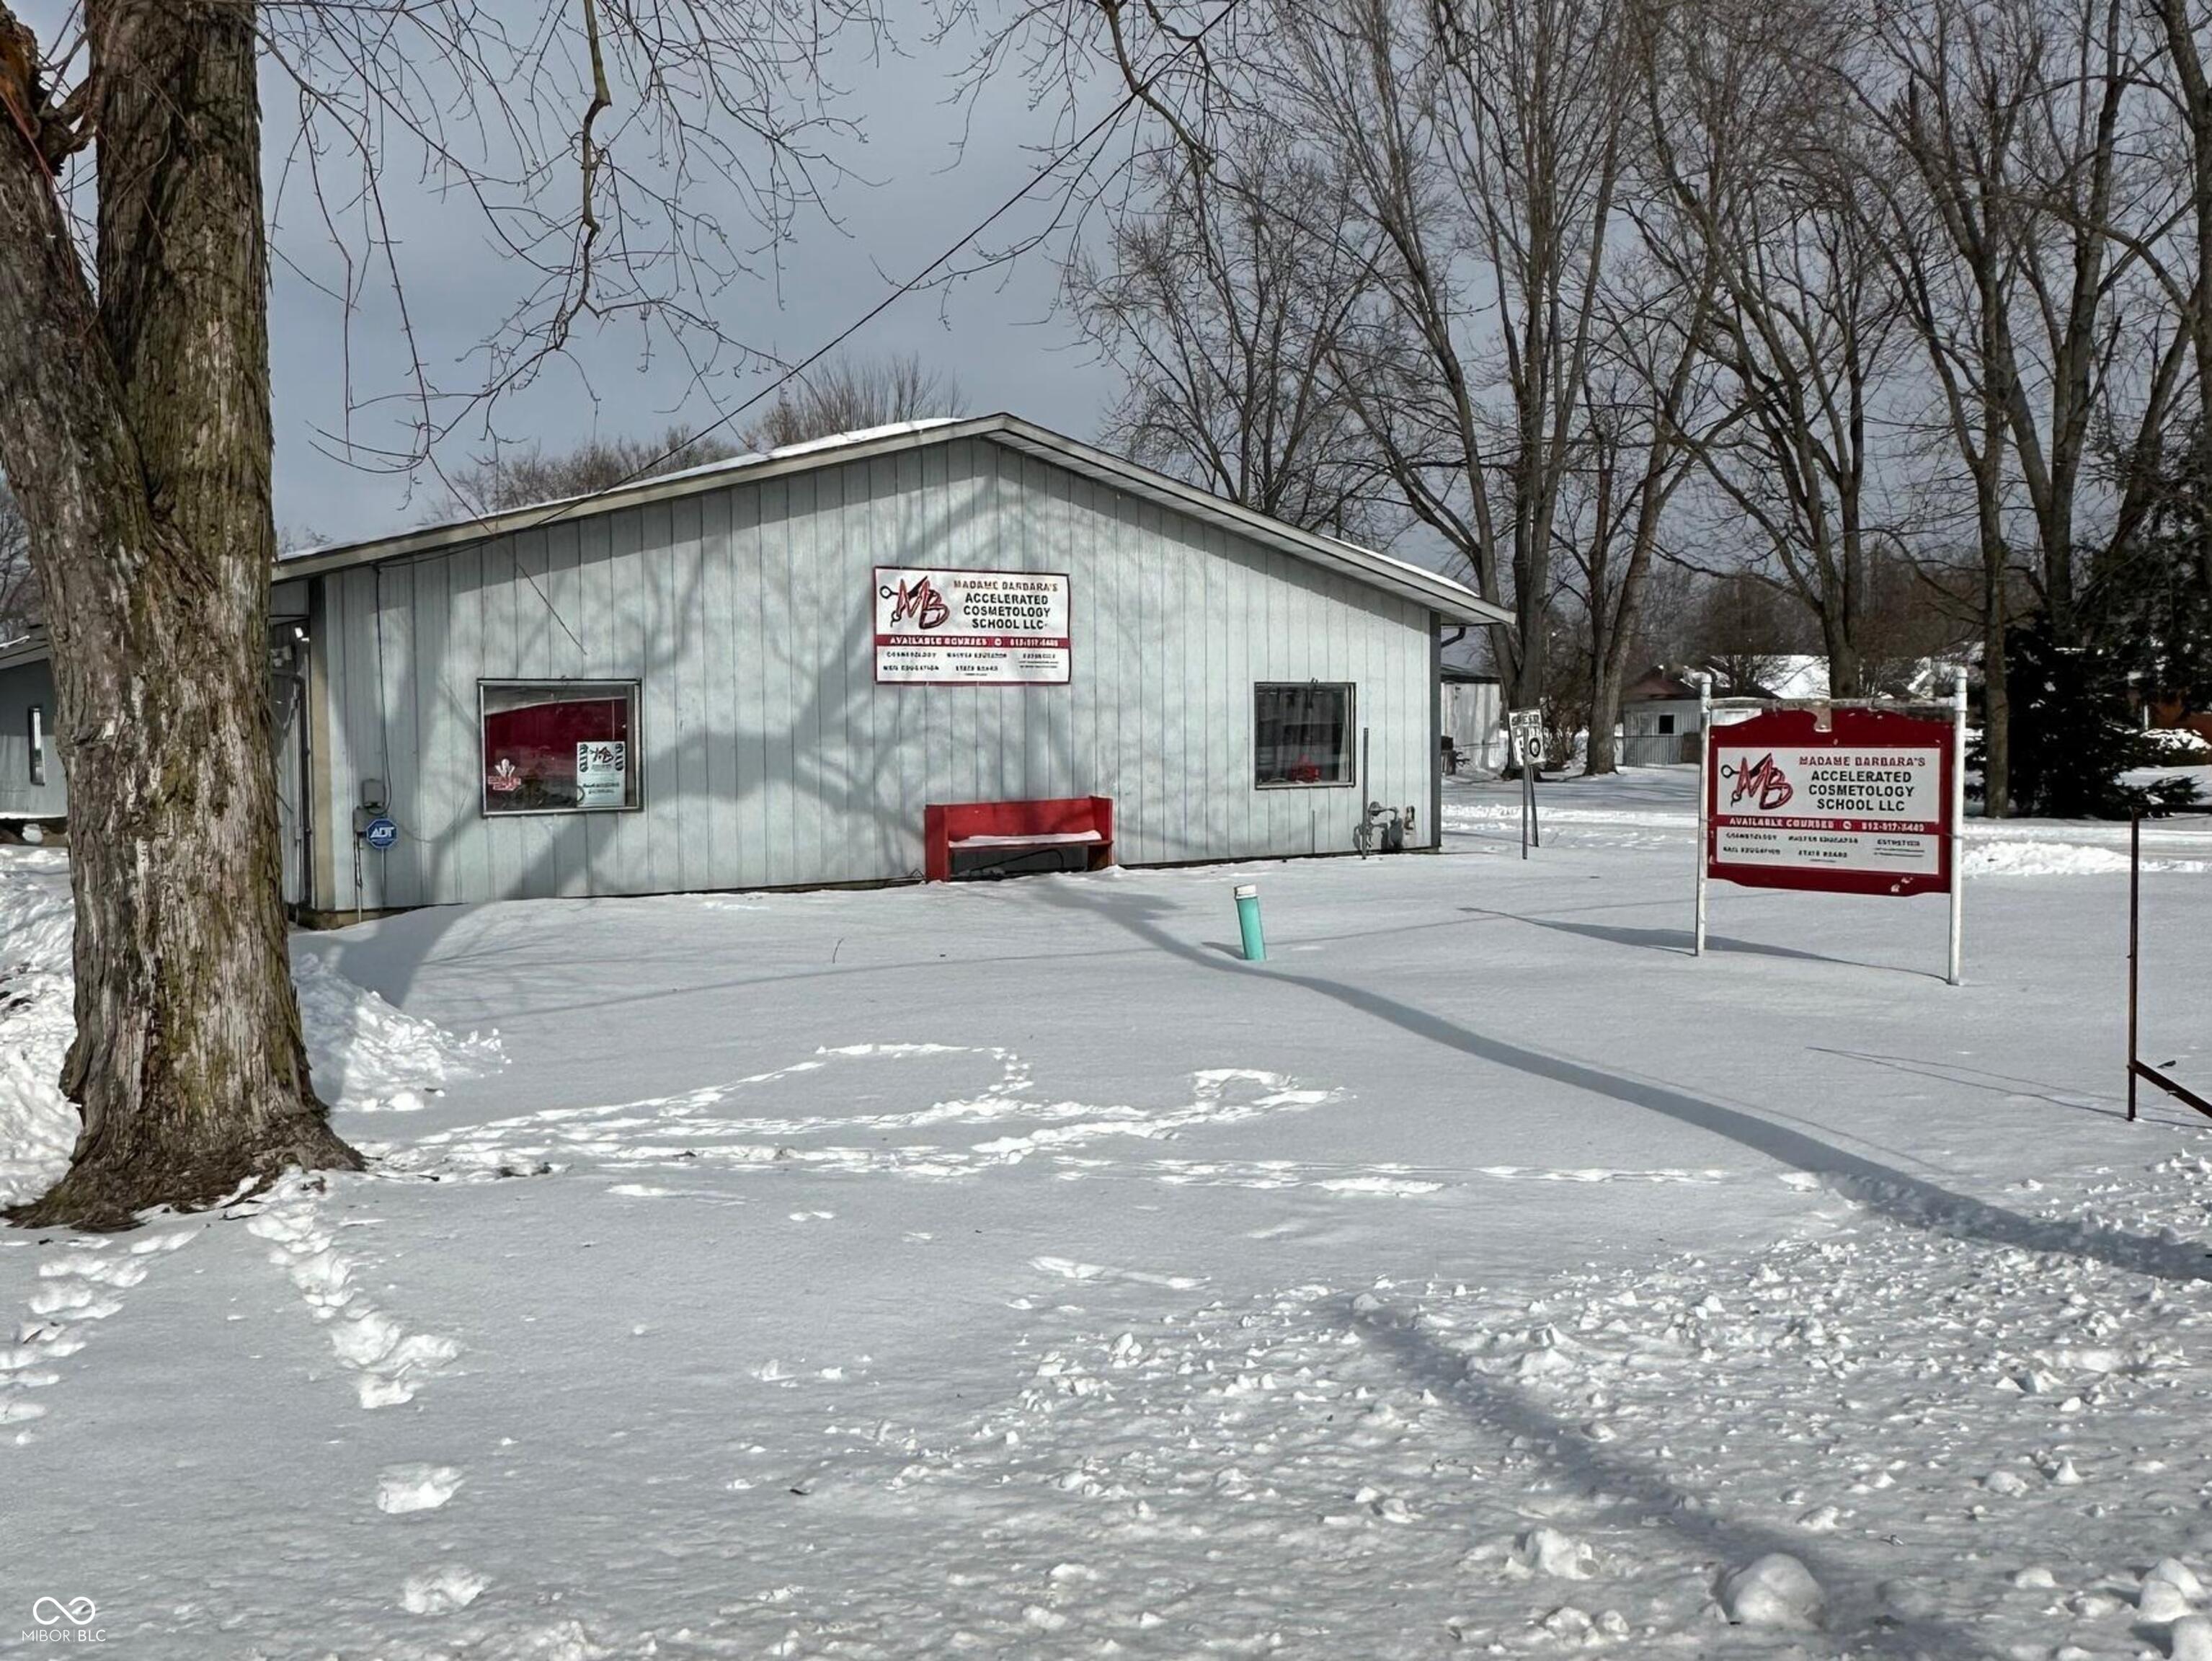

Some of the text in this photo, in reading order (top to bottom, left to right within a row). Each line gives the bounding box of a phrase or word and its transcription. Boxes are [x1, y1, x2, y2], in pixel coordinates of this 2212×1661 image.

[954, 580, 1059, 592] MADAME BARBARA'S
[964, 592, 1049, 605] ACCELERATED
[963, 605, 1051, 618] COSMETOLOGY
[972, 618, 1044, 630] SCHOOL LLC
[889, 636, 987, 647] AVAILABLE COURSES
[1799, 756, 1926, 766] MADAME BARBARA'S
[1811, 770, 1912, 783] ACCELERATED
[1808, 784, 1915, 797] COSMETOLOGY
[1816, 798, 1905, 812] SCHOOL LLC
[1730, 817, 1834, 829] AVAILABLE COURSES
[370, 827, 395, 838] ADT
